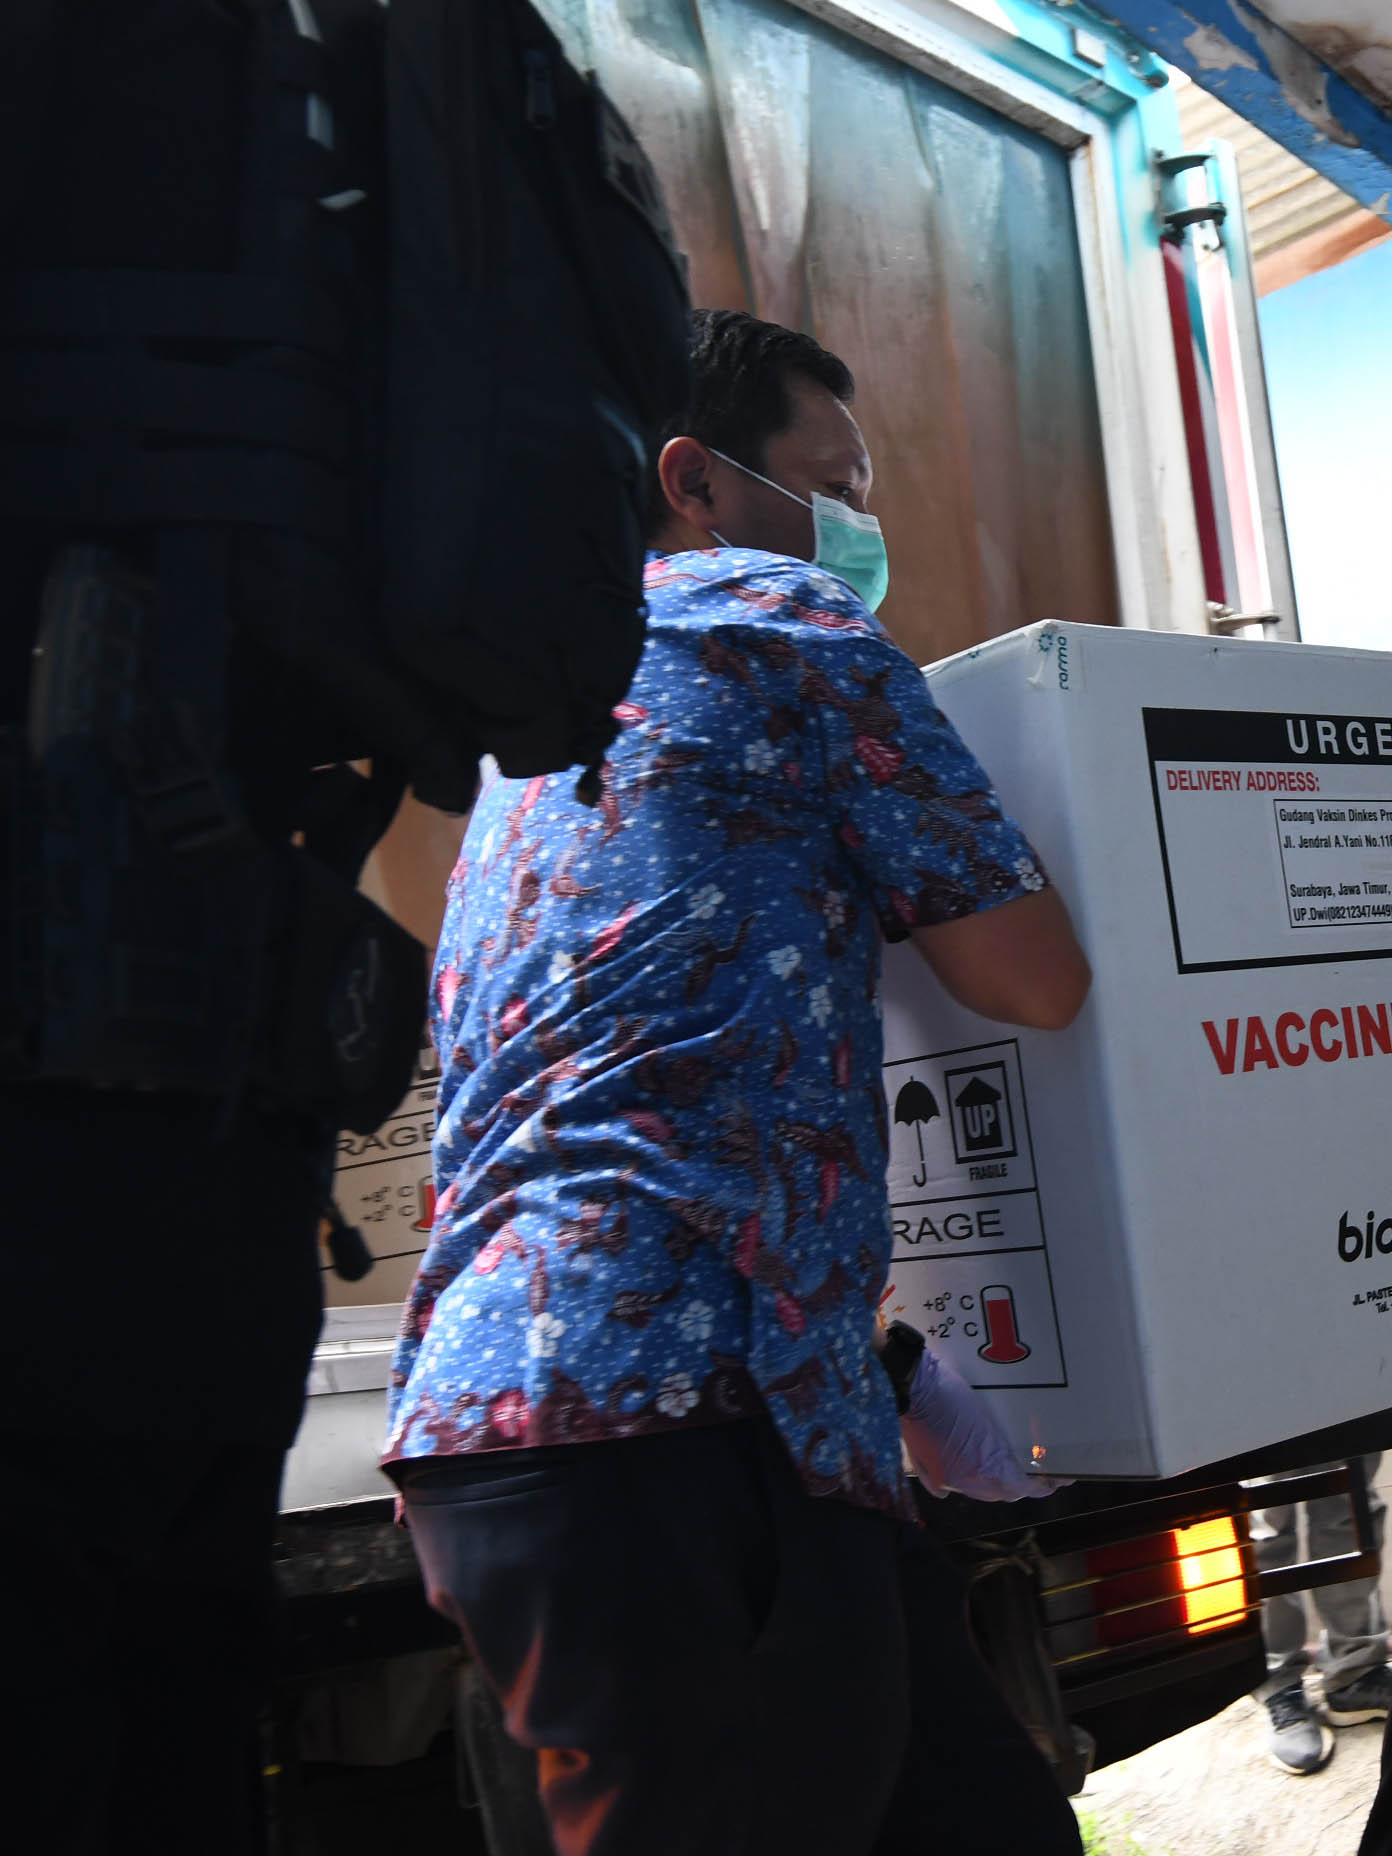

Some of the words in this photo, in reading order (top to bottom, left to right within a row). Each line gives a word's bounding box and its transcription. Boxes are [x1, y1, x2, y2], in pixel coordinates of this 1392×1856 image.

[1166, 769, 1241, 792] DELIVERY
[1246, 771, 1321, 792] ADDRESS:
[1279, 808, 1315, 824] Gudang
[1317, 808, 1346, 822] Vaksin
[1348, 808, 1378, 822] Dinkes
[1298, 835, 1332, 849] Jendral
[1334, 835, 1363, 848] A.Yani
[1290, 883, 1336, 899] Surabaya,
[1338, 882, 1361, 896] Jawa
[1362, 881, 1391, 896] Timur,
[965, 1103, 996, 1139] UP
[969, 1163, 1009, 1181] FRAGILE
[960, 1295, 975, 1310] C
[964, 1322, 978, 1337] C
